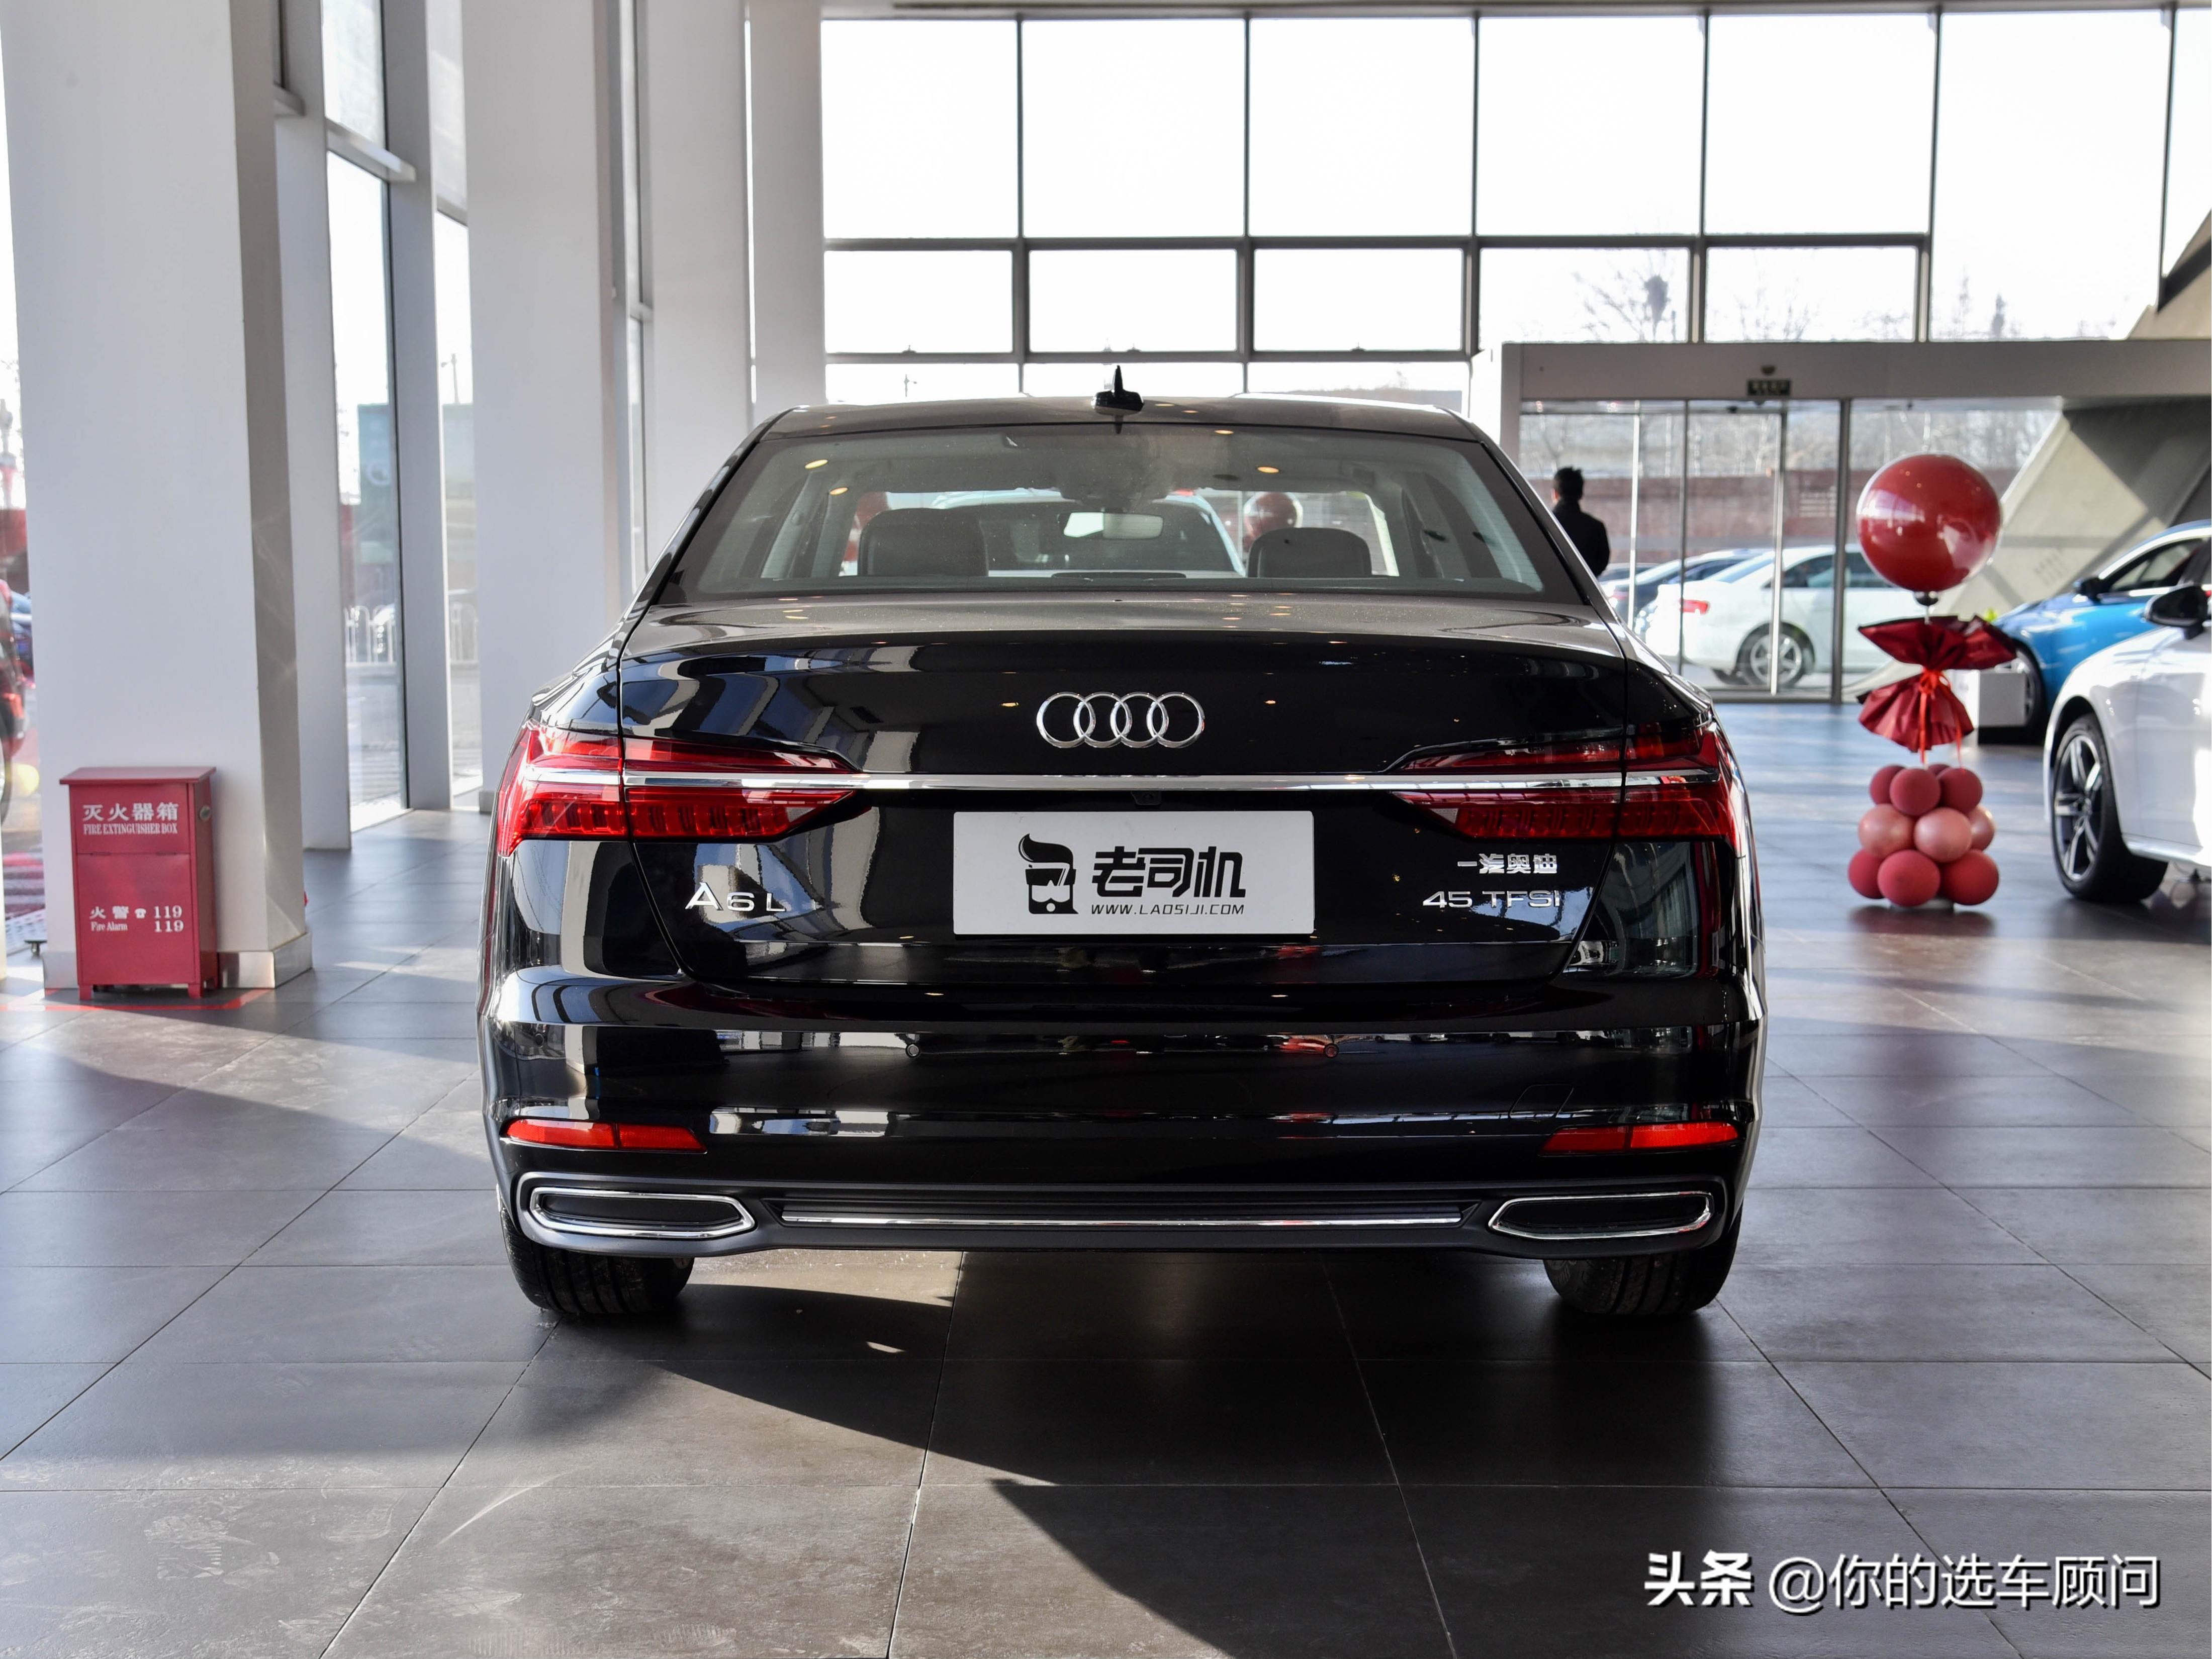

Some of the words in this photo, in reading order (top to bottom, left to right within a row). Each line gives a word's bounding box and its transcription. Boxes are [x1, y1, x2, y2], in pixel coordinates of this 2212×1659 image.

[82, 802, 178, 821] 灭火器箱
[83, 823, 102, 835] FIRE
[103, 823, 160, 835] EXTINGUISHER
[161, 822, 177, 834] BOX
[1092, 846, 1246, 897] 老司机
[1457, 853, 1557, 874] 一汽奥迪
[1423, 891, 1472, 908] 45
[1482, 890, 1560, 908] TFSI
[154, 905, 182, 919] 119
[1091, 904, 1245, 915] WWW.LAOSIJI.COM
[91, 921, 105, 932] Fire
[107, 921, 128, 931] Alarm
[155, 919, 184, 933] 119
